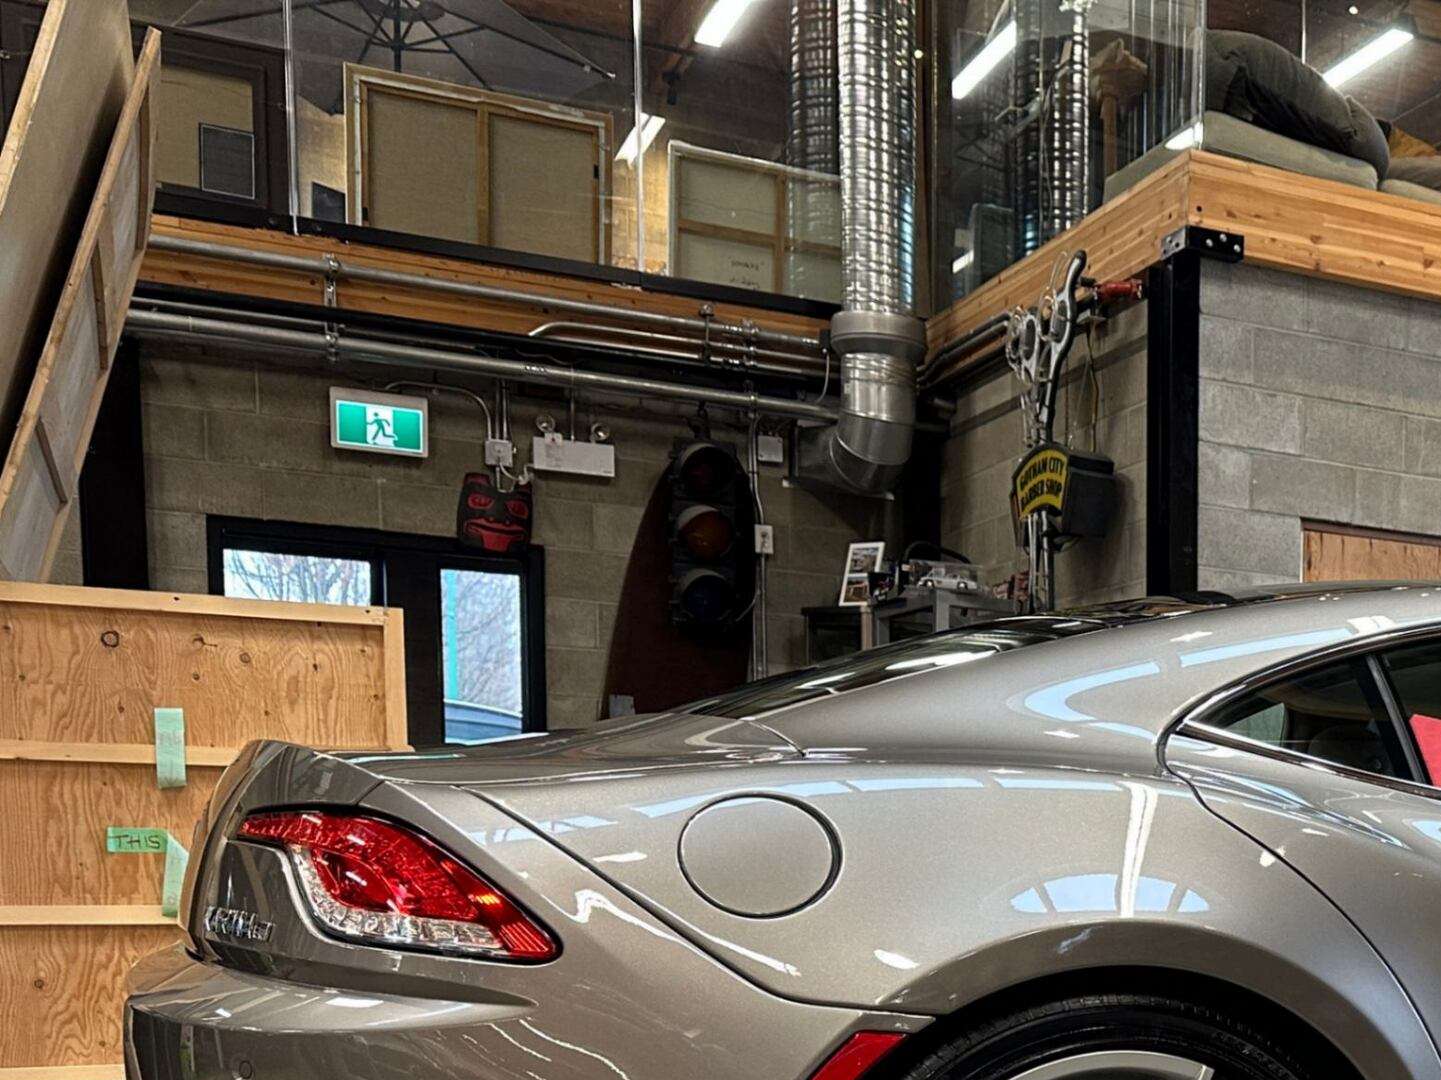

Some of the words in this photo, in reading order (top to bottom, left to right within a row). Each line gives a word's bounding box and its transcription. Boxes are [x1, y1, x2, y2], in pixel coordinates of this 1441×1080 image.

[1020, 456, 1049, 491] GOTHAM
[1048, 456, 1065, 476] CITY
[1021, 480, 1045, 511] BARBER
[1046, 478, 1063, 497] SHOP
[107, 834, 160, 850] THIS
